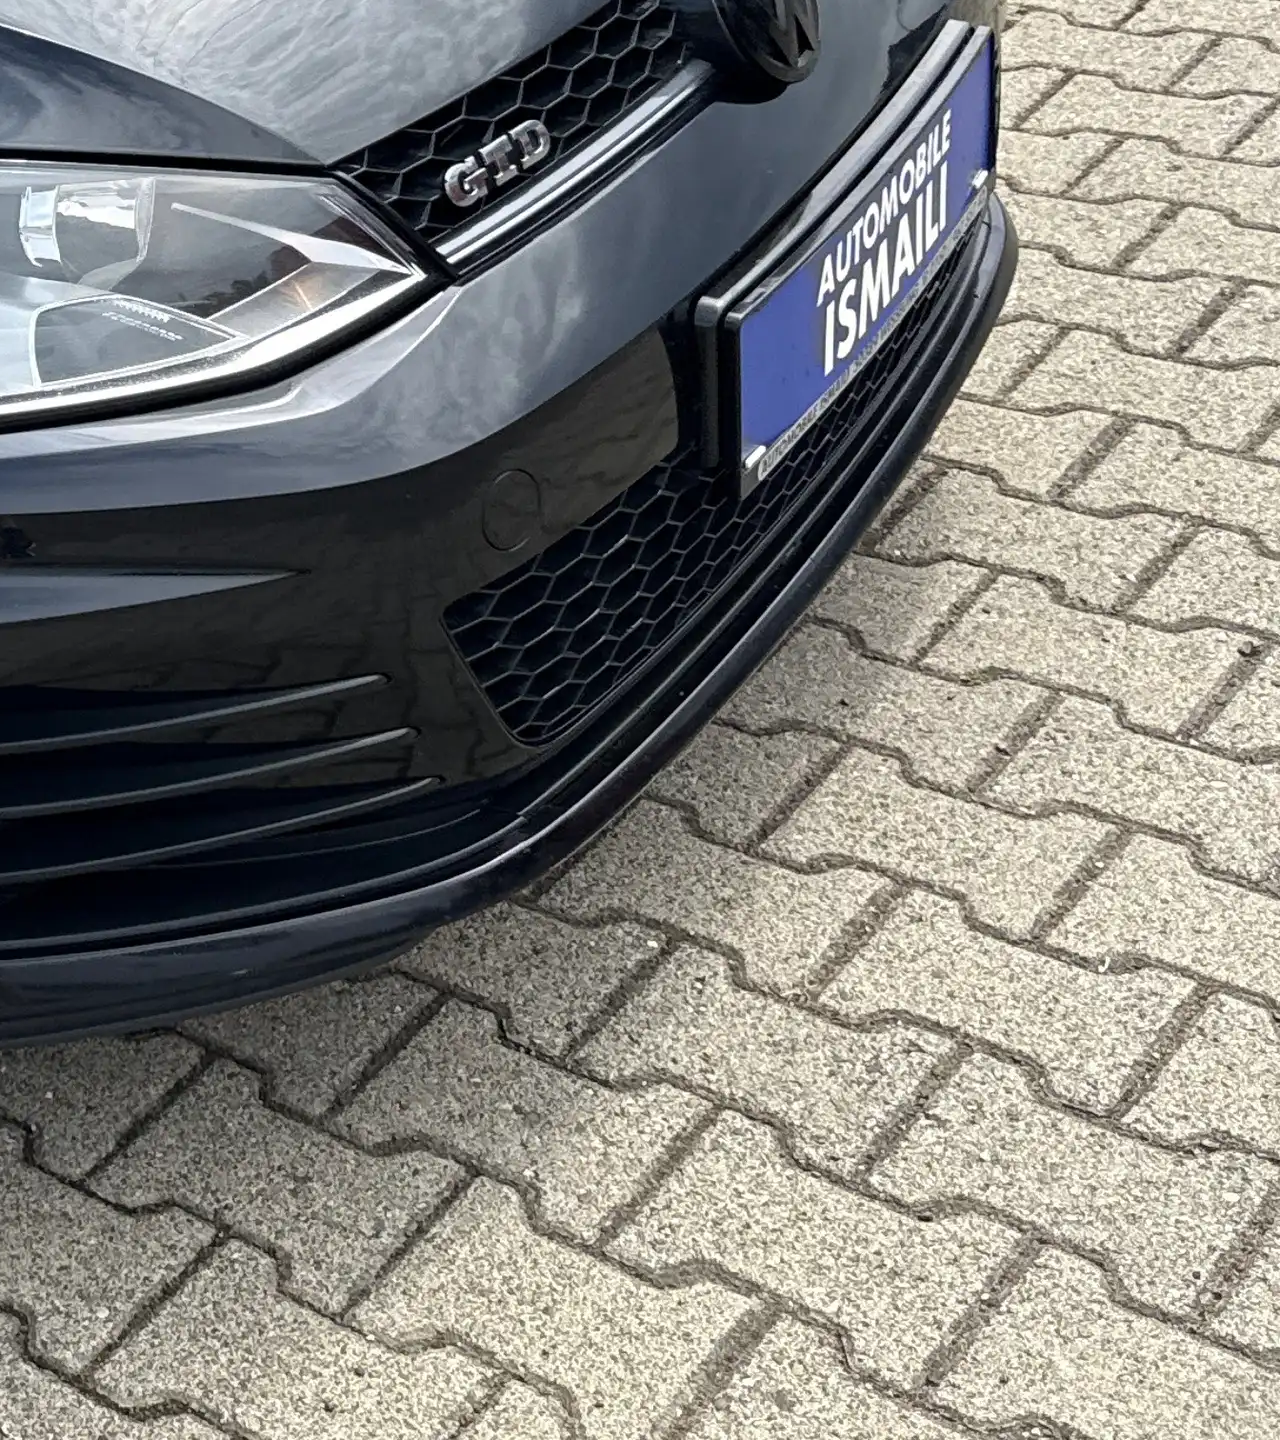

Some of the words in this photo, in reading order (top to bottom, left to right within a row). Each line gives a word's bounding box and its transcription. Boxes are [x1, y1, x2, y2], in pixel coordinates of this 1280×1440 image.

[444, 119, 551, 208] GTD
[817, 109, 952, 307] AUTOMOBILE
[823, 160, 950, 377] ISMAILI
